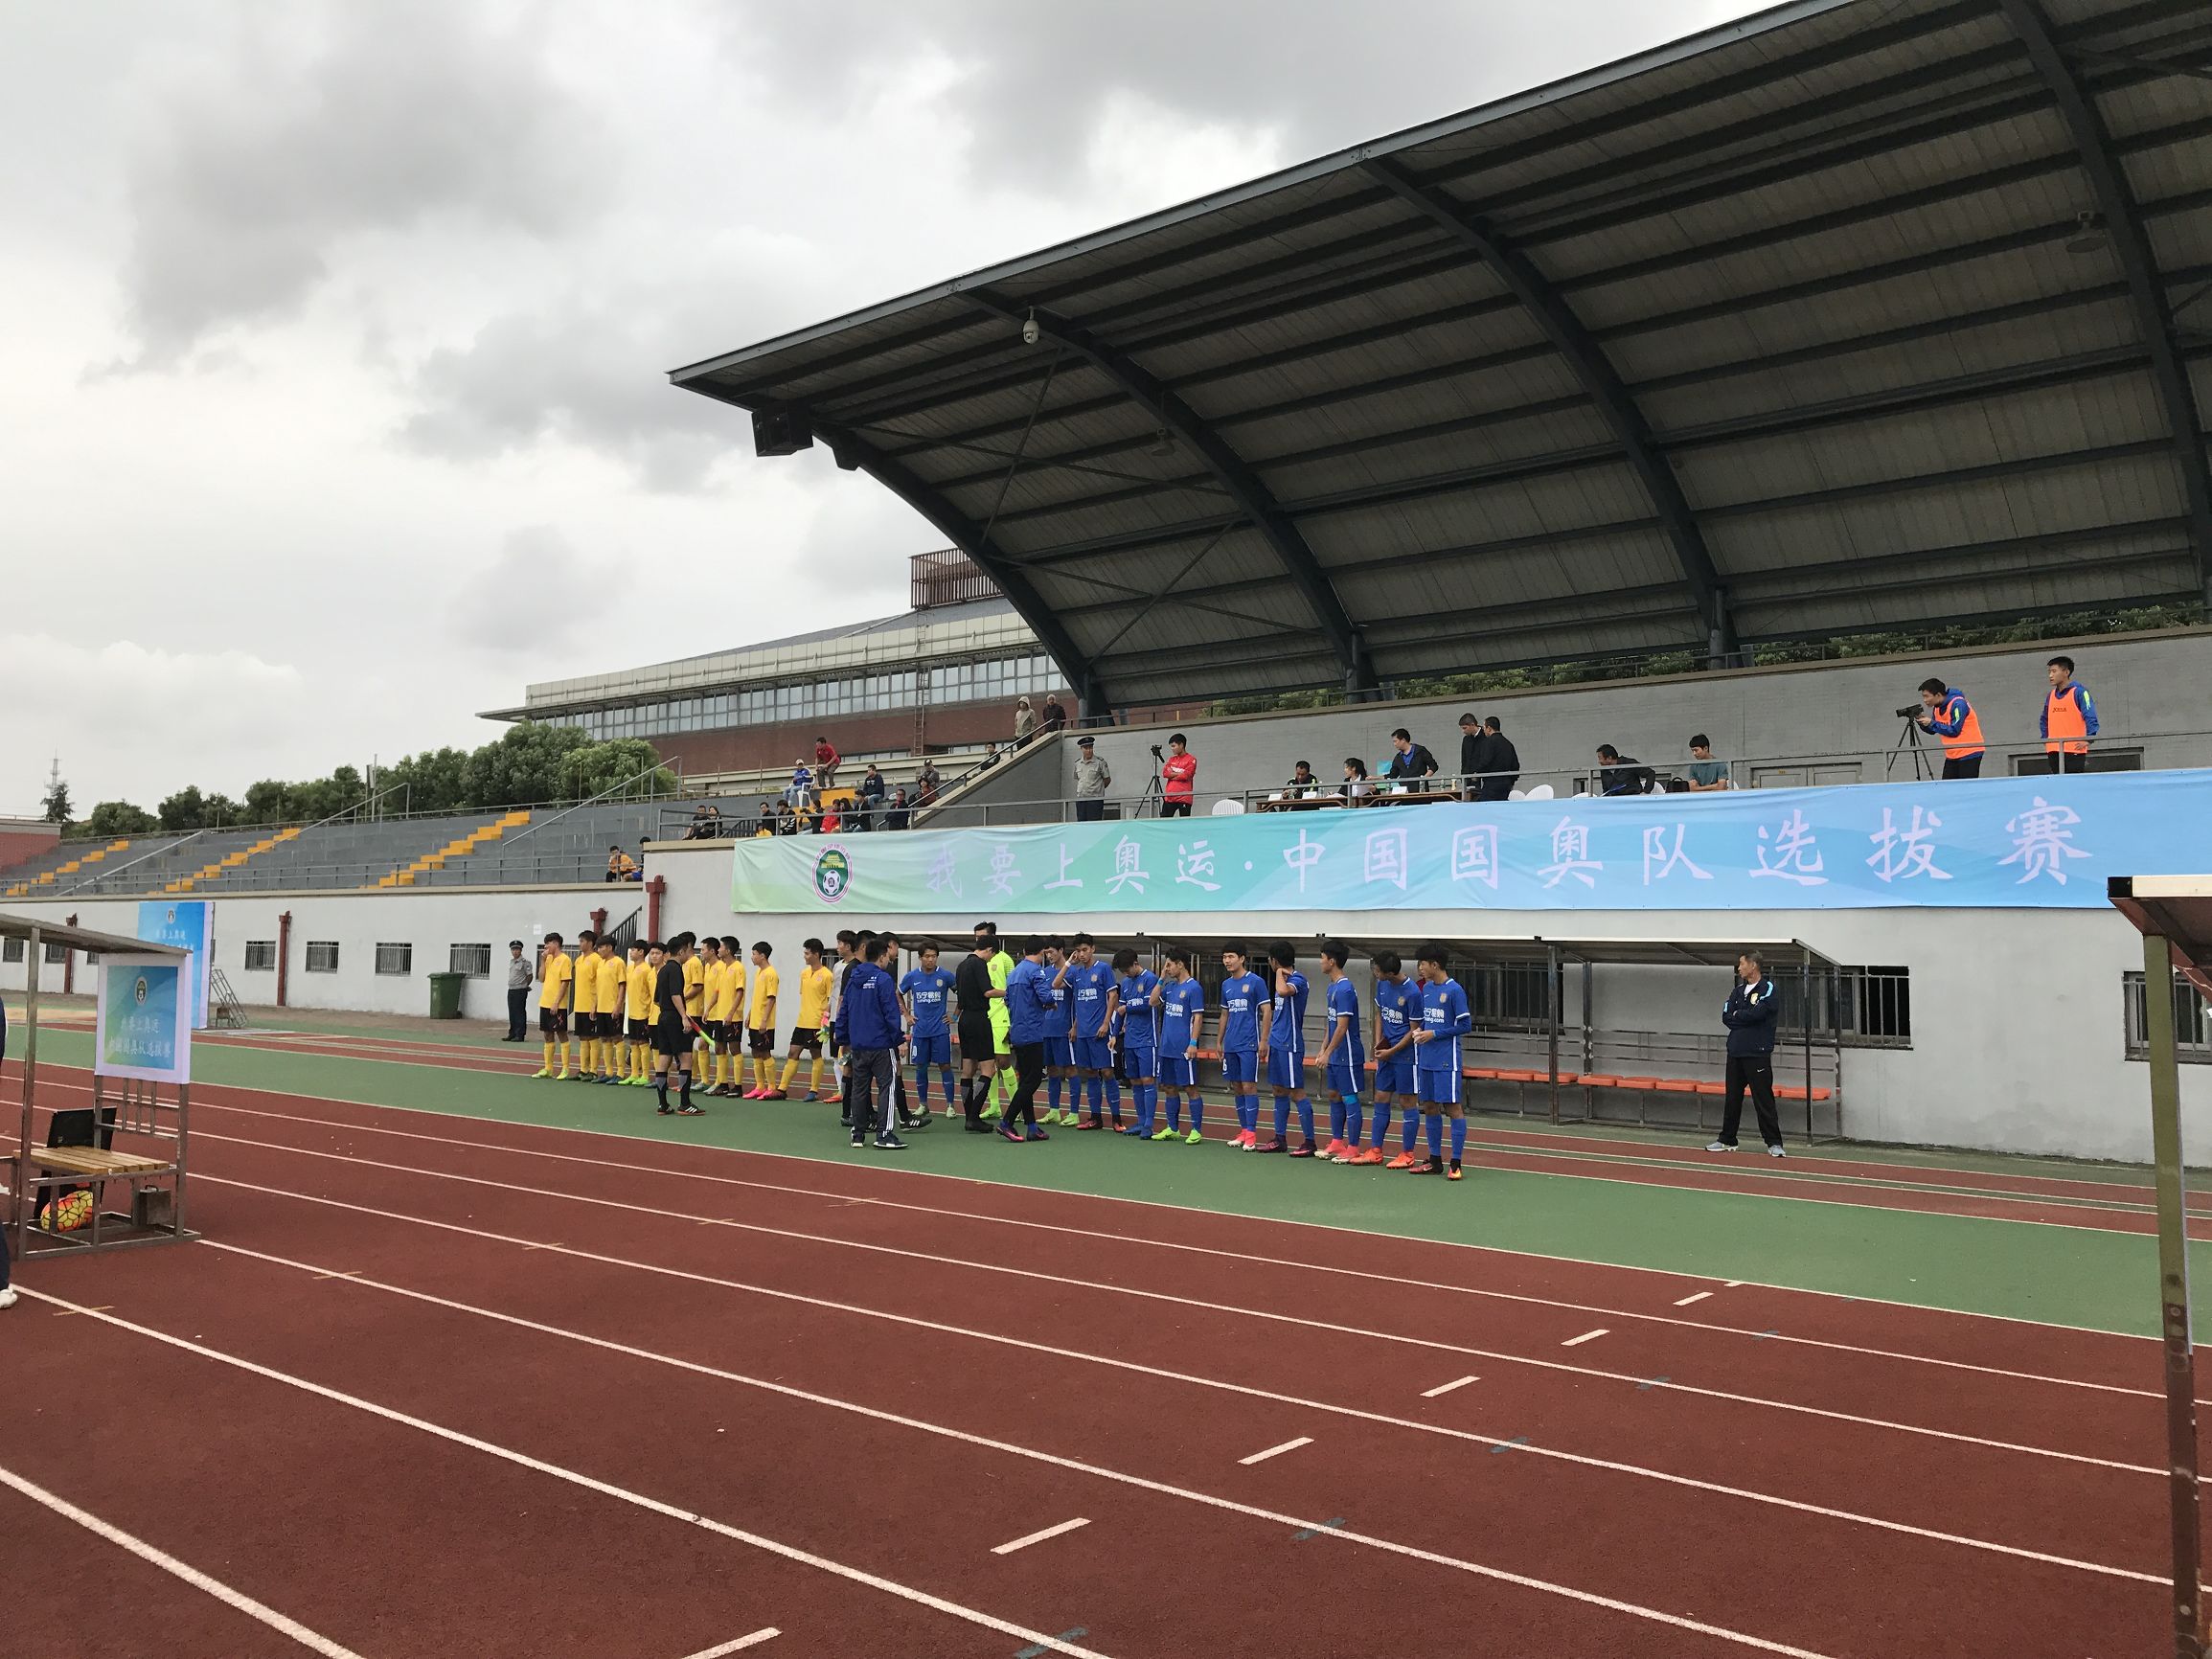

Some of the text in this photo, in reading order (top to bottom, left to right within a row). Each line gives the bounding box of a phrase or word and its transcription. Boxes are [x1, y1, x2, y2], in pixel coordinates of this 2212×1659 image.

[925, 796, 2094, 898] 我要上奥运·中国国奥队选拔赛
